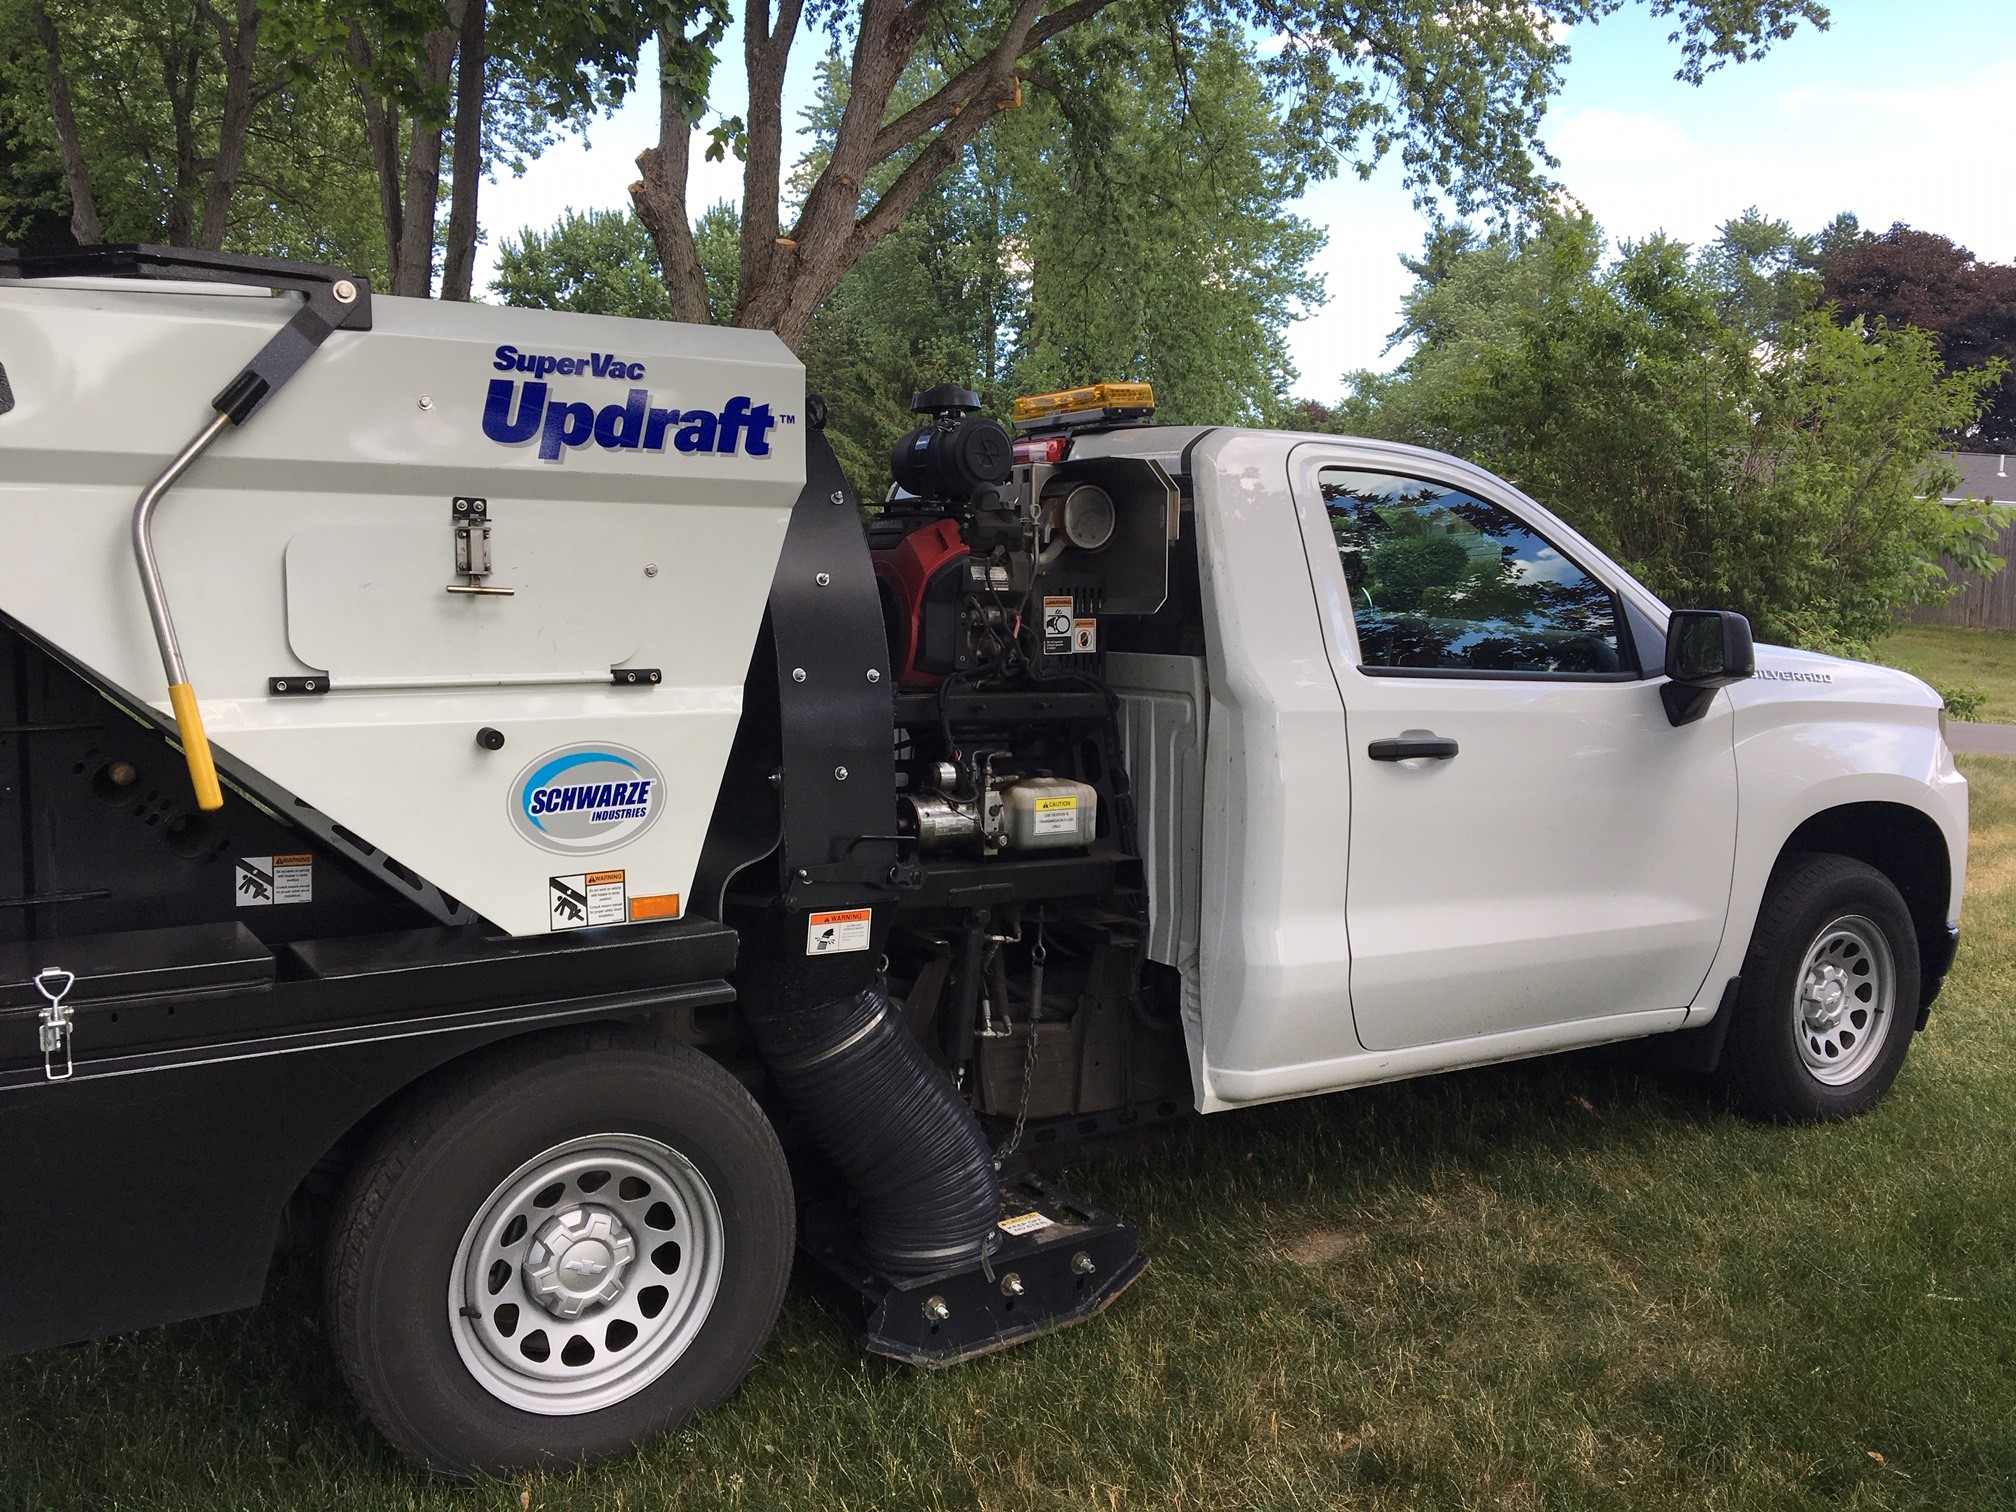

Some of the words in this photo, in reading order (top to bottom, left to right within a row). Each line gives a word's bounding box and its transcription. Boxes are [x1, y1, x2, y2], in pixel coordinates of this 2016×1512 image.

[493, 345, 646, 380] SuperVac
[482, 378, 776, 463] Updraft
[531, 780, 652, 814] SCHWARZE
[591, 806, 647, 822] INDUSTRIES
[831, 913, 862, 921] WARNING
